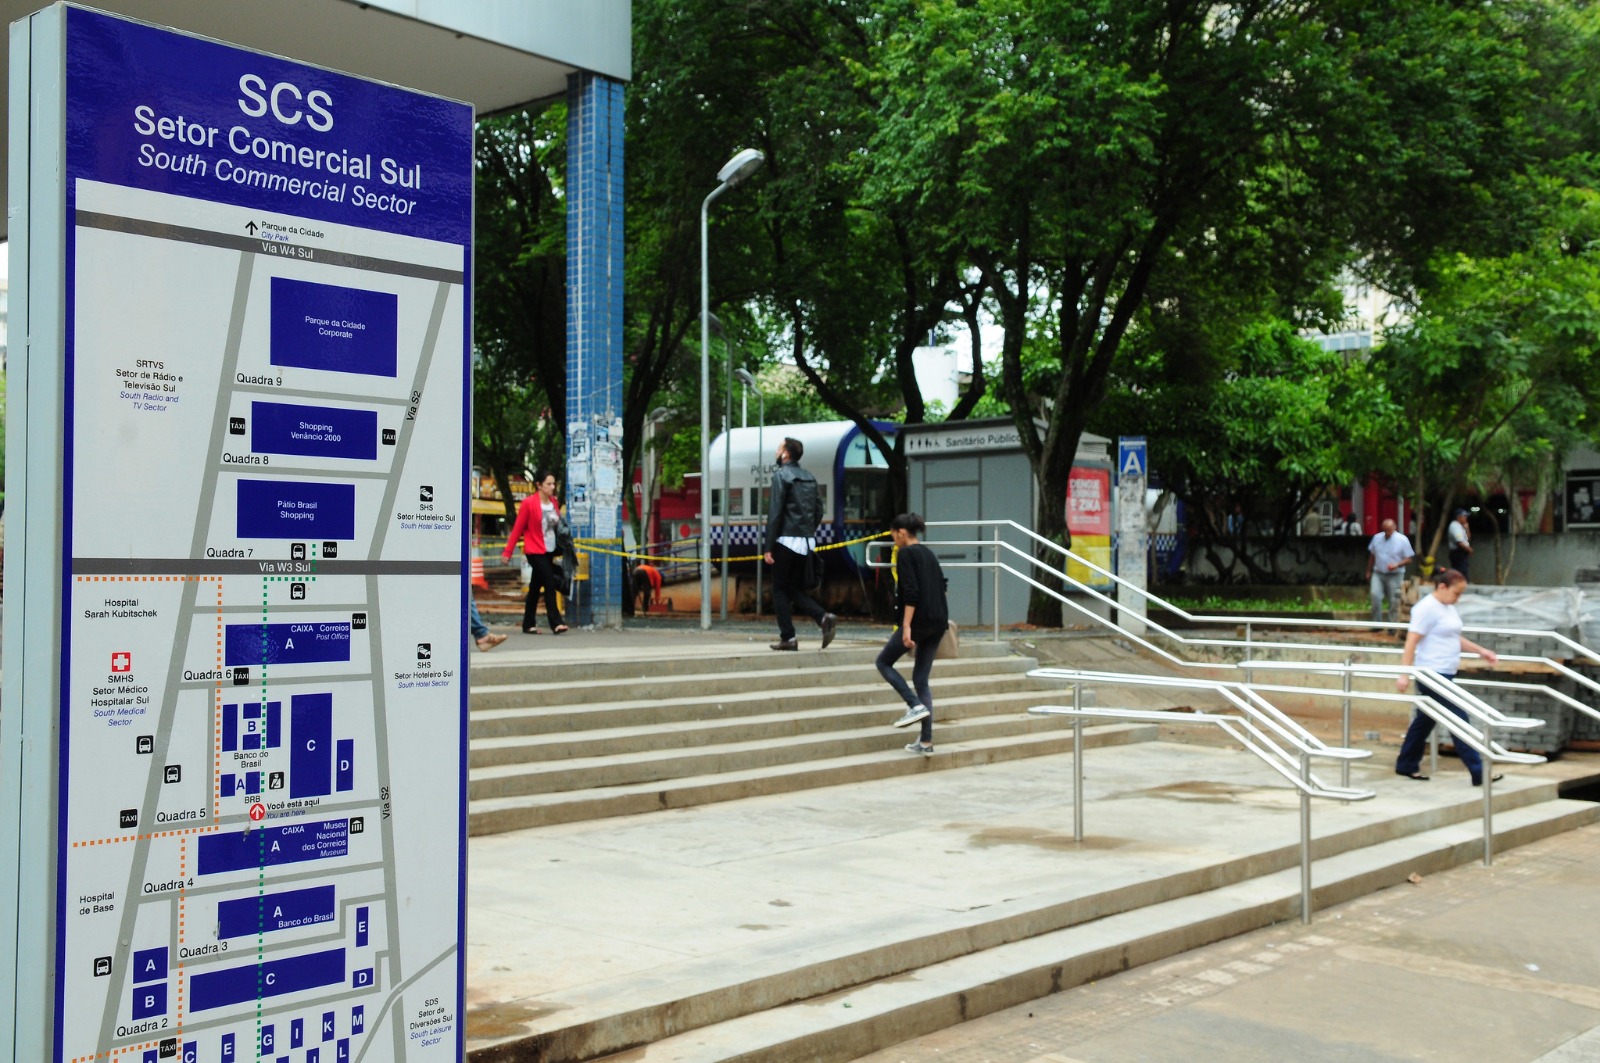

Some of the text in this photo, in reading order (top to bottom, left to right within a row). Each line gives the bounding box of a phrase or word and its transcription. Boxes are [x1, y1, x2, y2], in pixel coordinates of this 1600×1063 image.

[238, 73, 334, 132] SCS
[134, 105, 420, 189] Setor Comercial Sul
[138, 143, 417, 215] South Commercial Sector
[261, 221, 324, 239] Parque da Cidade
[261, 231, 289, 242] City Park
[261, 241, 313, 259] Via W4 Sul
[305, 315, 366, 331] Parque da Cidade
[318, 327, 353, 339] Corporate
[136, 359, 164, 369] SRTVS
[116, 369, 138, 378] Setor
[140, 371, 151, 379] de
[153, 371, 176, 382] Rádio
[236, 373, 282, 386] Quadra 9
[124, 381, 176, 392] Televisão Sul
[120, 391, 179, 403] South Radio and
[133, 402, 167, 412] TV Sector
[406, 391, 421, 421] Via S2
[230, 422, 245, 430] TÁXI
[300, 422, 333, 432] Shopping
[291, 431, 341, 442] Venâncio 2000
[382, 432, 396, 441] TÁXI
[946, 436, 985, 448] Sanitário
[223, 453, 269, 465] Quadra 8
[1122, 450, 1142, 474] A
[277, 501, 317, 509] Pátio Brasil
[280, 511, 314, 521] Shopping
[397, 513, 456, 522] Setor Hoteleiro Sul
[400, 522, 416, 530] South
[206, 548, 254, 558] Quadra 7
[259, 562, 310, 572] Via W3 Sul
[104, 599, 139, 608] Hospital
[84, 609, 158, 618] Sarah Kubitschek
[320, 624, 350, 632] Correios
[284, 638, 294, 650] A
[108, 674, 134, 683] SMHS
[184, 670, 232, 681] Quadra 6
[234, 672, 248, 680] TÁXI
[394, 672, 410, 680] Setor
[443, 670, 453, 678] Sul
[432, 680, 450, 688] Sector
[92, 686, 148, 695] Setor Médico
[90, 696, 150, 707] Hospitalar Sul
[94, 707, 146, 718] South Medical
[108, 718, 132, 726] Sector
[248, 720, 256, 732] B
[306, 740, 316, 752] C
[234, 750, 269, 760] Banco do
[340, 760, 350, 771] D
[236, 778, 245, 790] A
[244, 796, 260, 804] BRB
[266, 798, 320, 810] Você está aqui
[381, 786, 390, 820] Via S2
[120, 814, 137, 822] TÁXI
[156, 808, 206, 822] Quadra 5
[291, 808, 306, 816] here
[282, 825, 305, 836] CAIXA
[324, 822, 346, 830] Museu
[316, 830, 346, 840] Nacional
[270, 840, 280, 852] A
[302, 840, 346, 851] dos Correios
[320, 848, 346, 858] Museum
[144, 878, 194, 894] Quadra 4
[79, 892, 115, 904] Hospital
[79, 904, 114, 916] de Base
[273, 906, 283, 918] A
[278, 912, 334, 928] Banco do Brasil
[358, 921, 366, 933] E
[180, 941, 228, 958] Quadra 3
[145, 959, 156, 972] A
[266, 972, 276, 985] C
[358, 972, 368, 984] D
[144, 996, 155, 1008] B
[424, 998, 439, 1007] SDS
[418, 1006, 445, 1018] Setor de
[324, 1020, 332, 1033] K
[352, 1014, 363, 1027] M
[410, 1014, 453, 1030] Diversões Sul
[116, 1018, 168, 1037] Quadra 2
[410, 1024, 452, 1040] South Leisure
[262, 1034, 272, 1046] G
[420, 1037, 442, 1048] Sector
[160, 1043, 176, 1052] TÁXI
[224, 1042, 232, 1055] E
[339, 1047, 346, 1058] L
[184, 1051, 194, 1063] C
